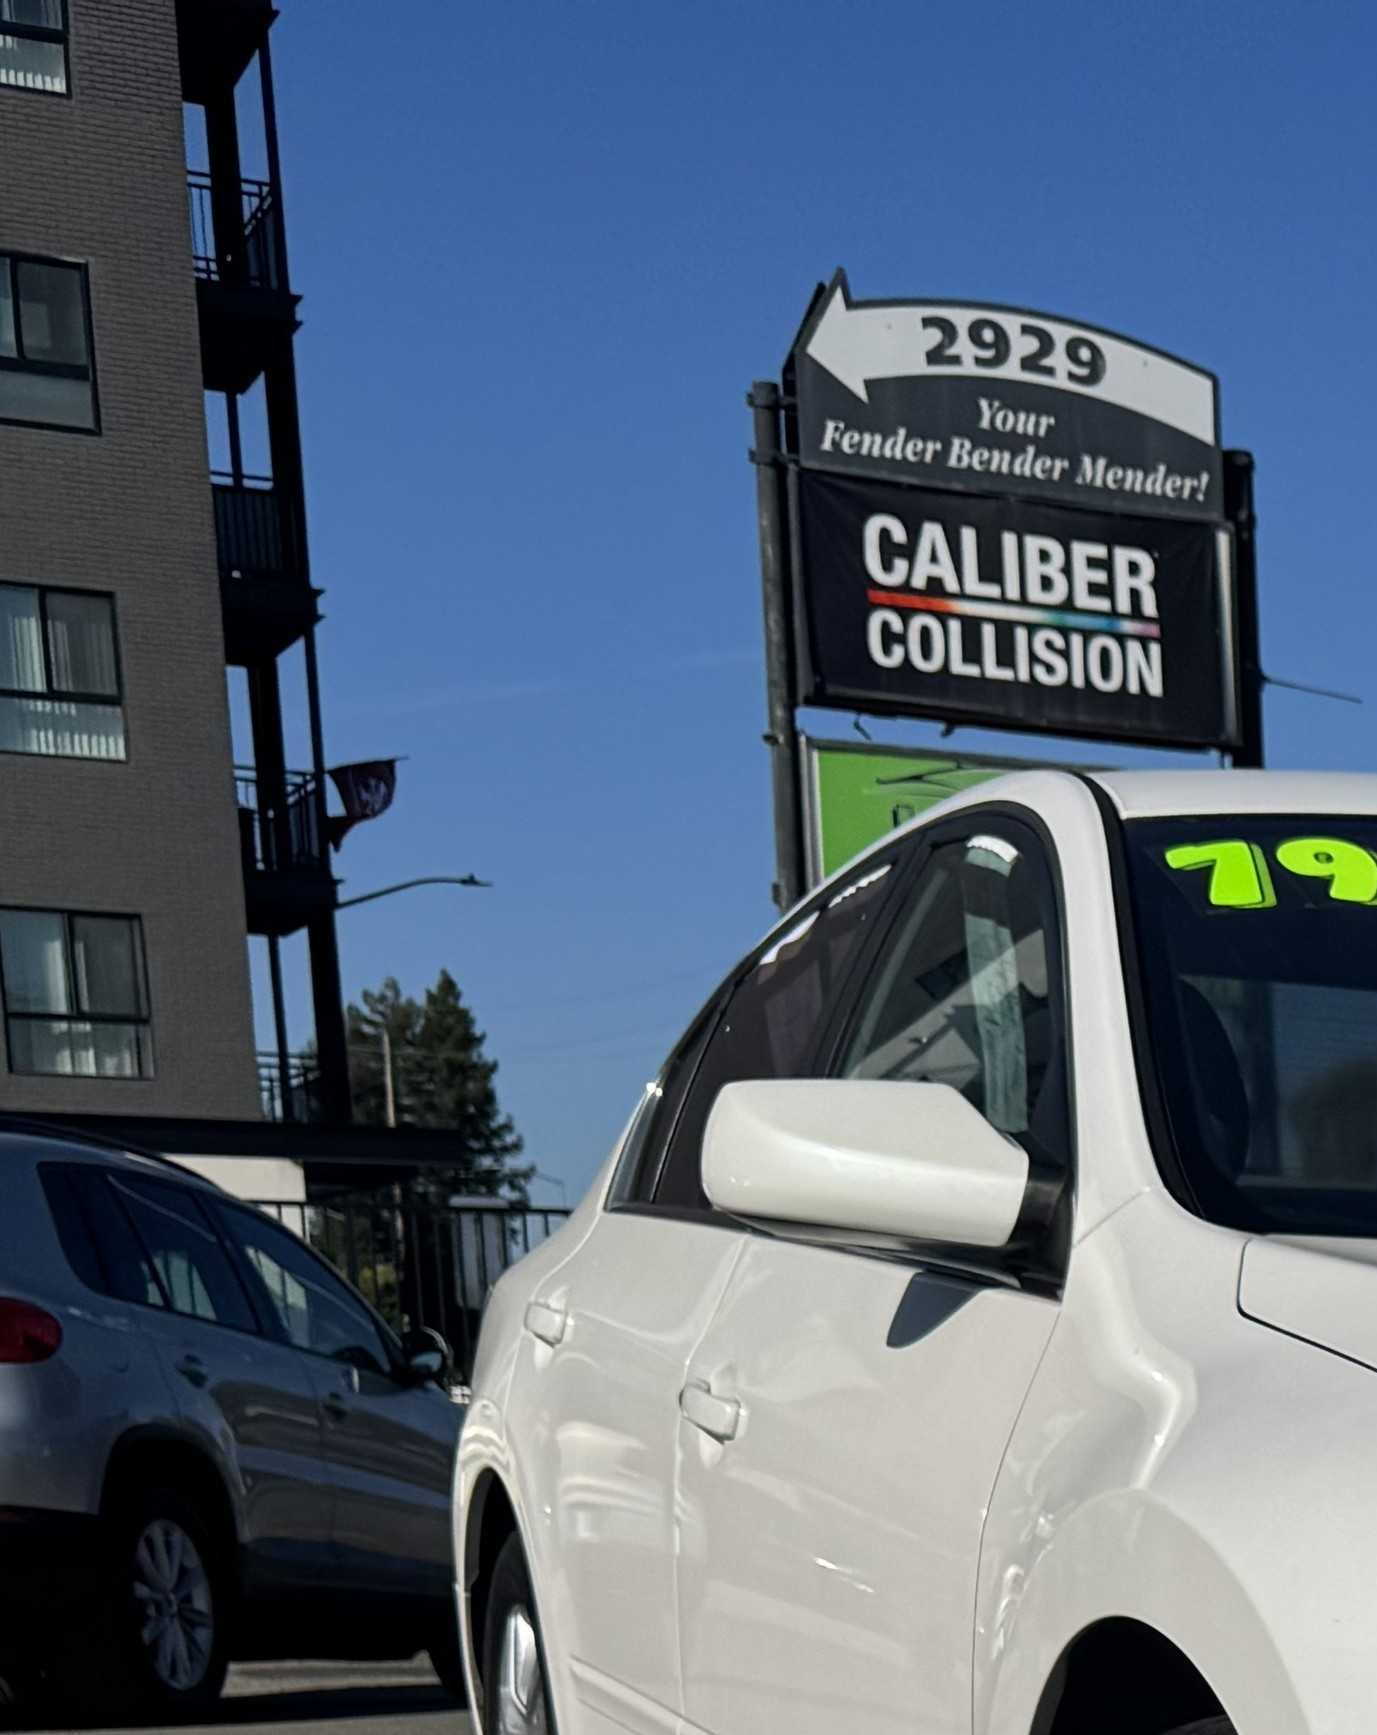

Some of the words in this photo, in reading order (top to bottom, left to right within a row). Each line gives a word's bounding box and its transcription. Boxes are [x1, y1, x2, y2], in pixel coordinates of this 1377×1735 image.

[921, 316, 1106, 387] 2929
[977, 398, 1055, 438] Your
[820, 420, 941, 465] Fender
[947, 437, 1069, 482] Bender
[1076, 453, 1209, 502] Mender!
[863, 513, 1159, 618] CALIBER
[867, 609, 1163, 698] COLLISION
